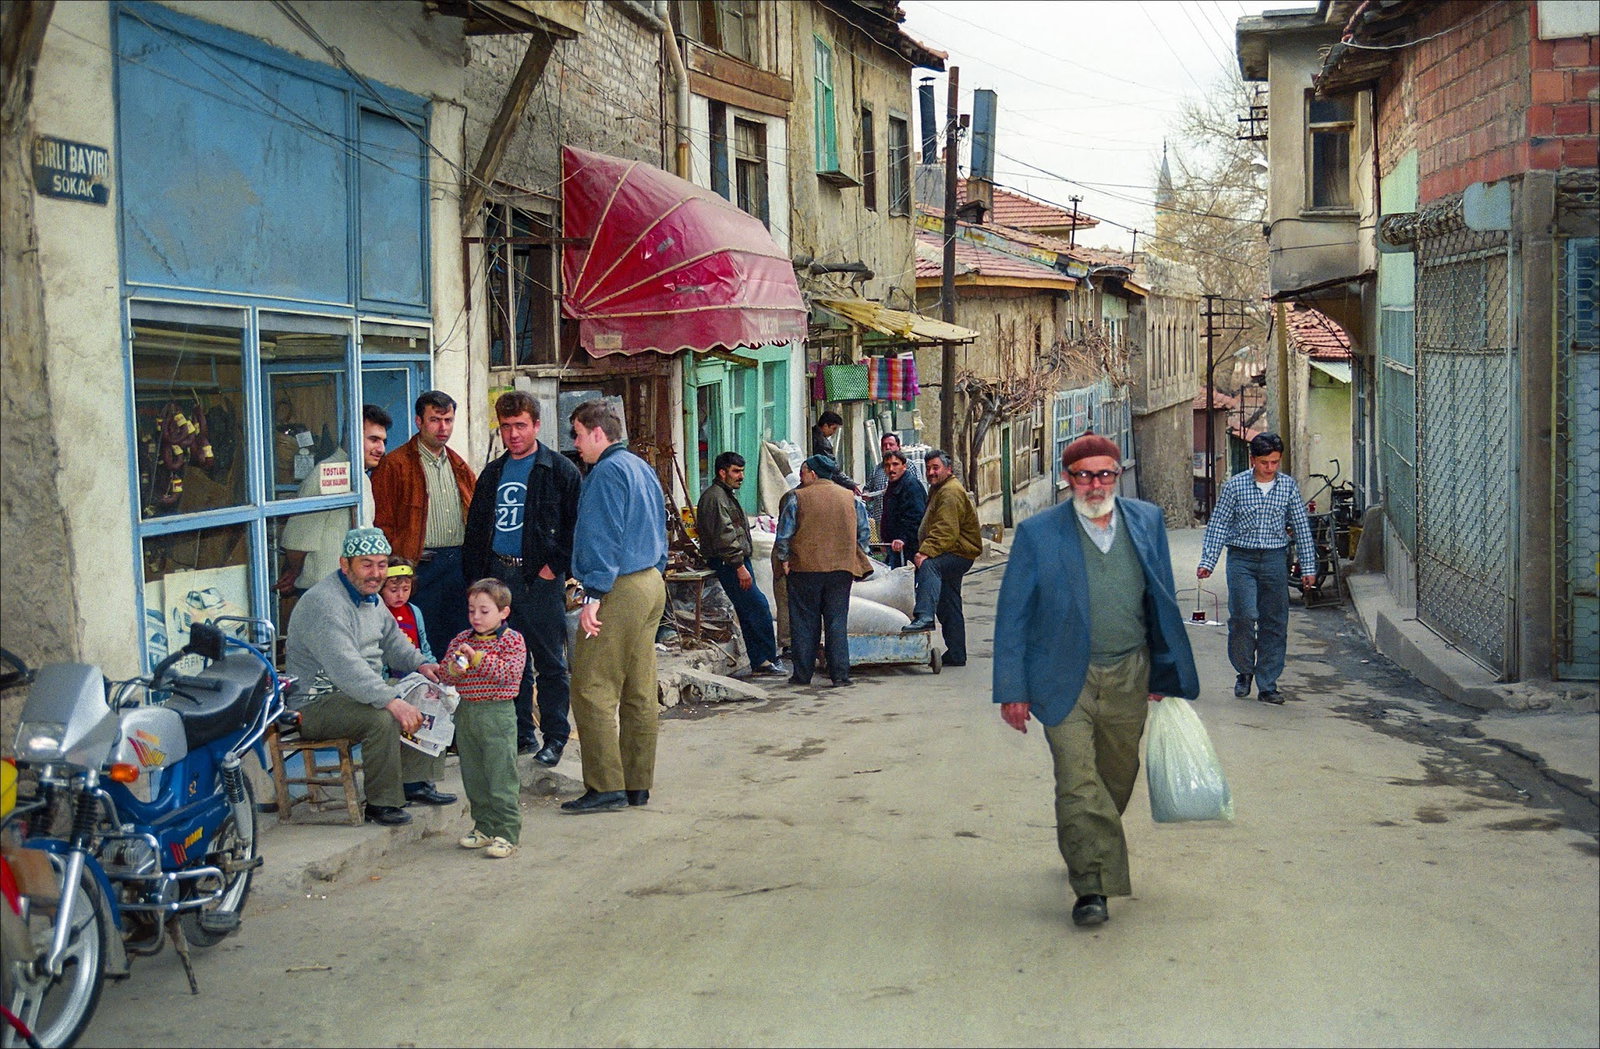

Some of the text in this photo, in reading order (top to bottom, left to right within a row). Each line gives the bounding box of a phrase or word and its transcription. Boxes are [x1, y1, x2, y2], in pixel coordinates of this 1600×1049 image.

[53, 175, 95, 197] SOKAK
[323, 467, 347, 476] TOSTLUK
[503, 486, 519, 504] C
[497, 507, 518, 526] 21
